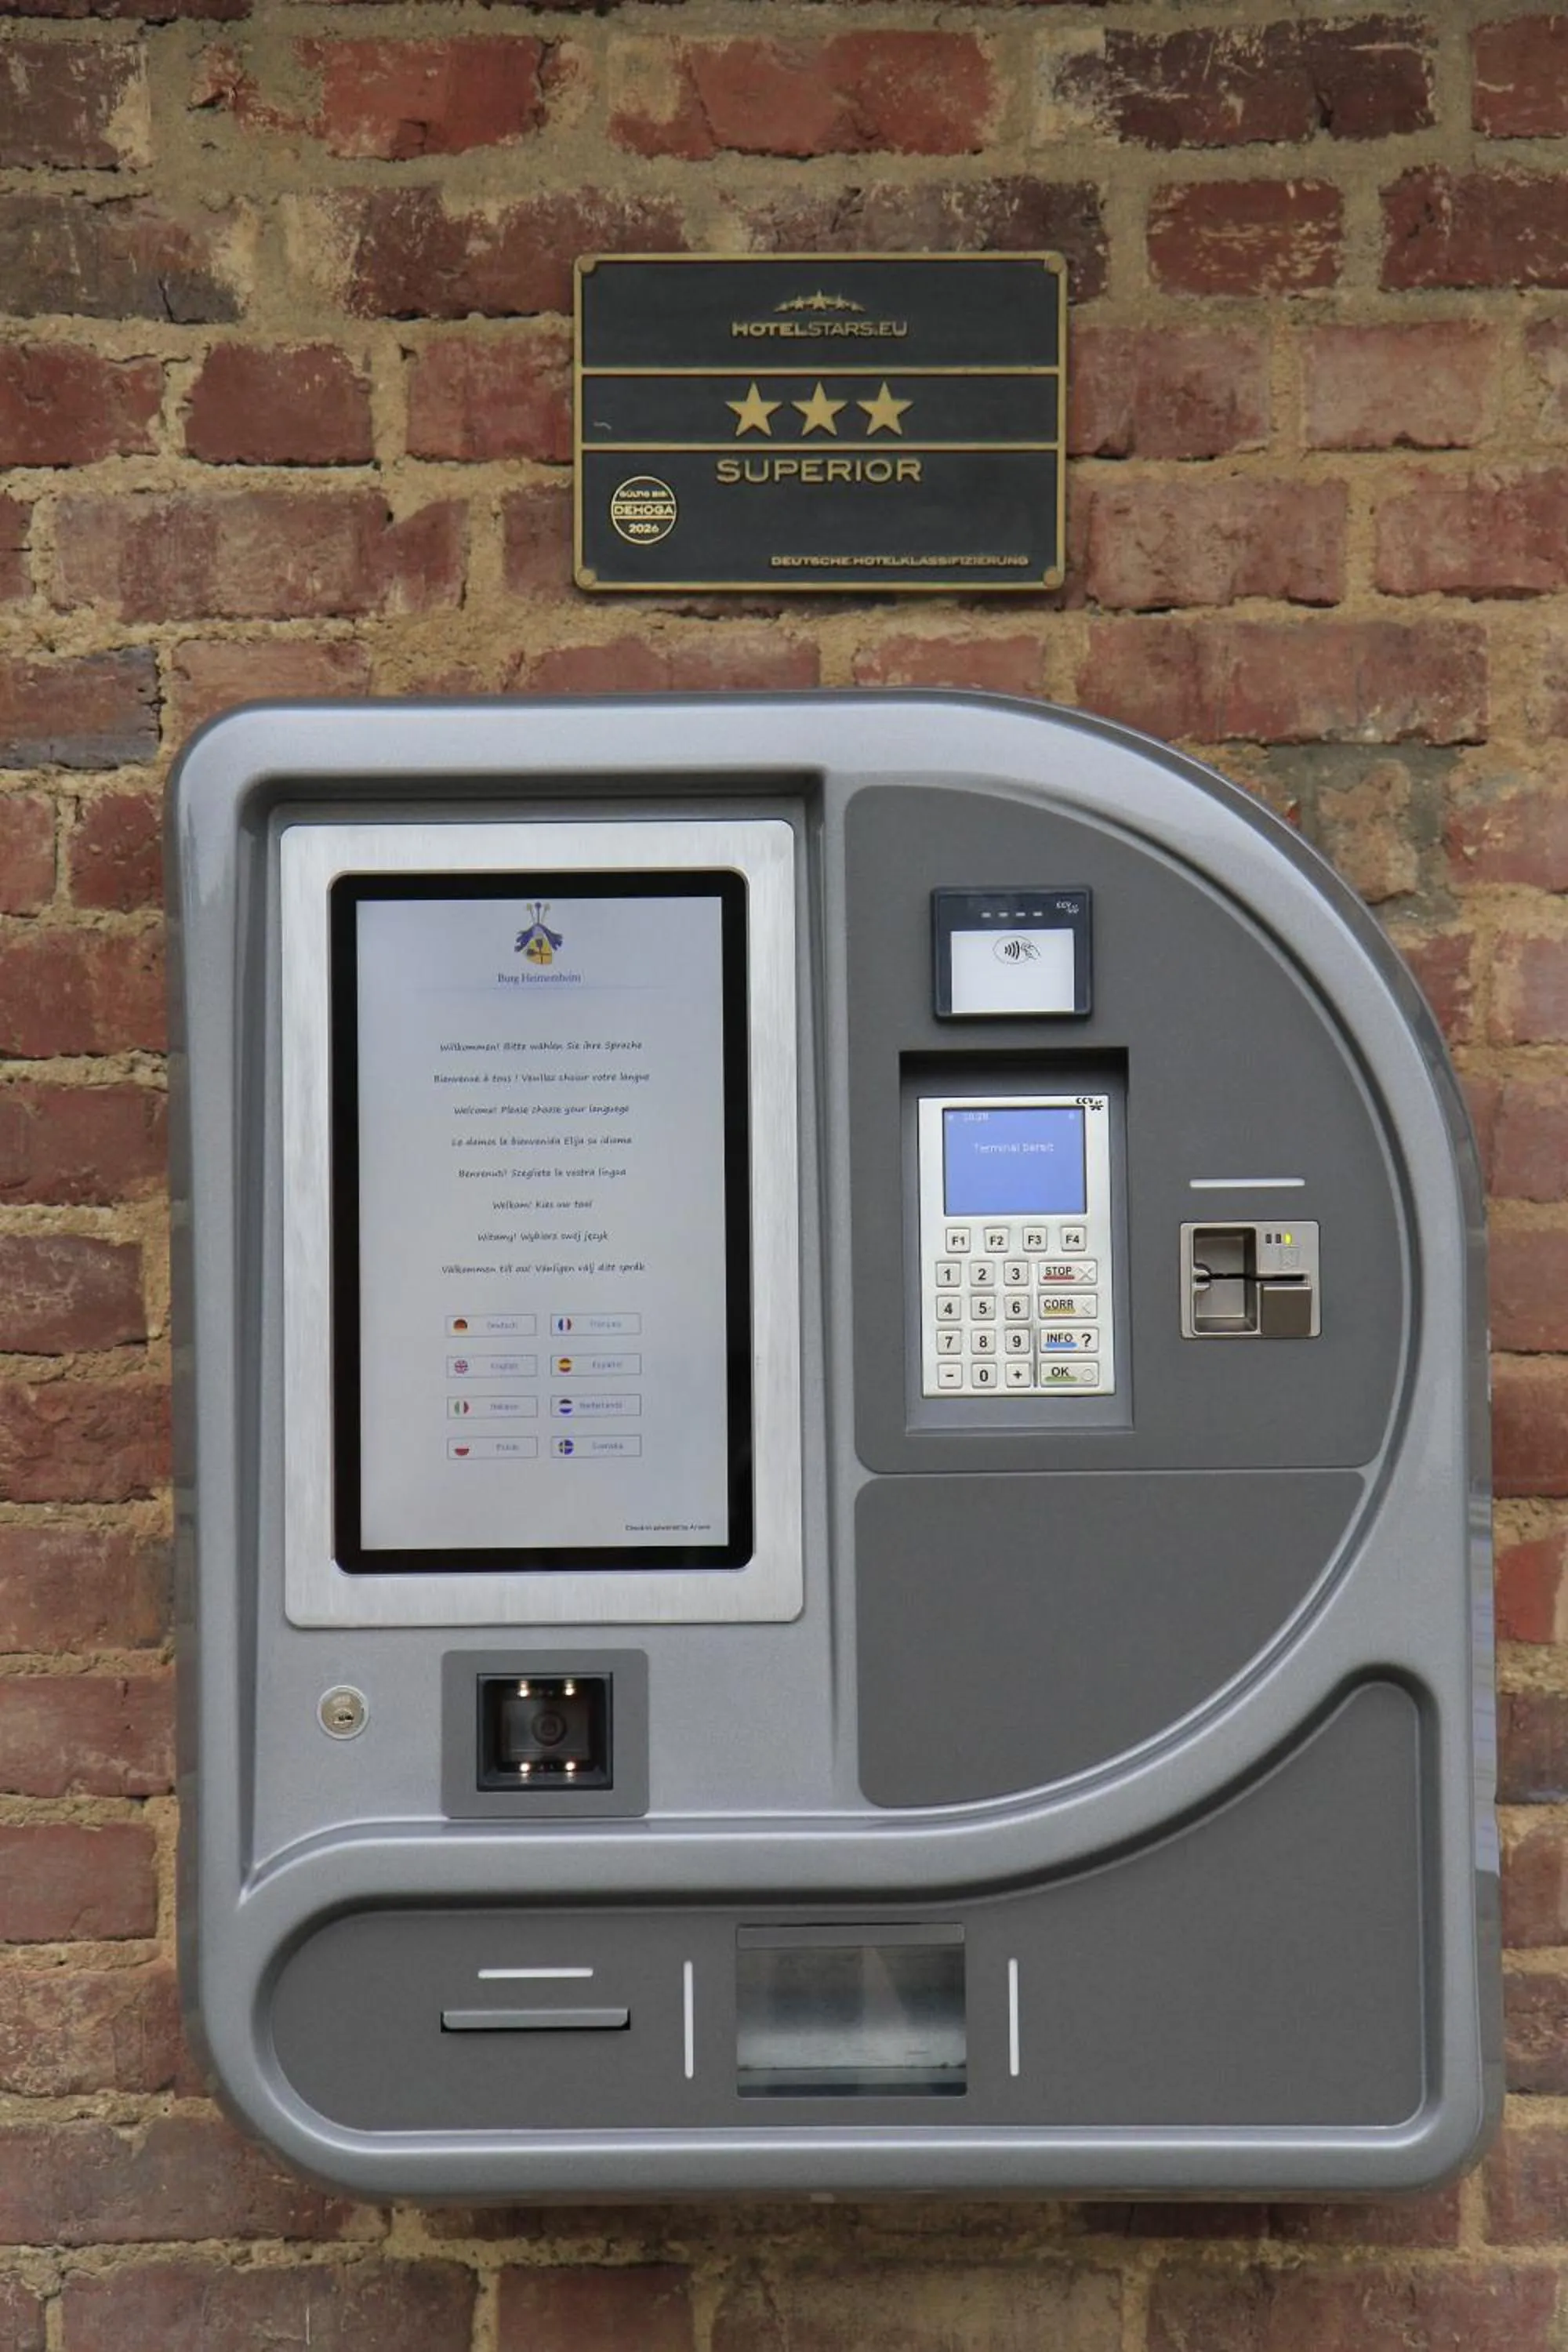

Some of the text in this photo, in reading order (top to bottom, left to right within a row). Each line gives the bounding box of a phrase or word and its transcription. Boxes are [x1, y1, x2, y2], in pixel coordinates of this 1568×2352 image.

[731, 321, 909, 338] HOTELSTARS.EU
[716, 459, 923, 484] SUPERIOR
[614, 504, 674, 515] DEHOGA
[629, 523, 659, 534] 2026
[771, 555, 852, 566] DEUTSCHE
[567, 1041, 580, 1050] Sie
[605, 1041, 642, 1052] Sprache
[974, 1142, 1019, 1153] Terminal
[952, 1236, 965, 1247] F1
[990, 1236, 1004, 1247] F2
[1028, 1235, 1042, 1245] F3
[1066, 1235, 1080, 1245] F4
[944, 1269, 951, 1281] 1
[978, 1269, 986, 1280] 2
[1012, 1268, 1020, 1280] 3
[1045, 1266, 1072, 1276] STOP
[944, 1302, 953, 1315] 4
[979, 1302, 987, 1314] 5
[1012, 1301, 1021, 1314] 6
[1044, 1299, 1073, 1309] CORR
[945, 1336, 953, 1348] 7
[979, 1335, 987, 1348] 8
[1013, 1335, 1022, 1348] 9
[1047, 1333, 1073, 1343] INFO
[979, 1370, 989, 1381] 0
[1051, 1367, 1069, 1377] OK
